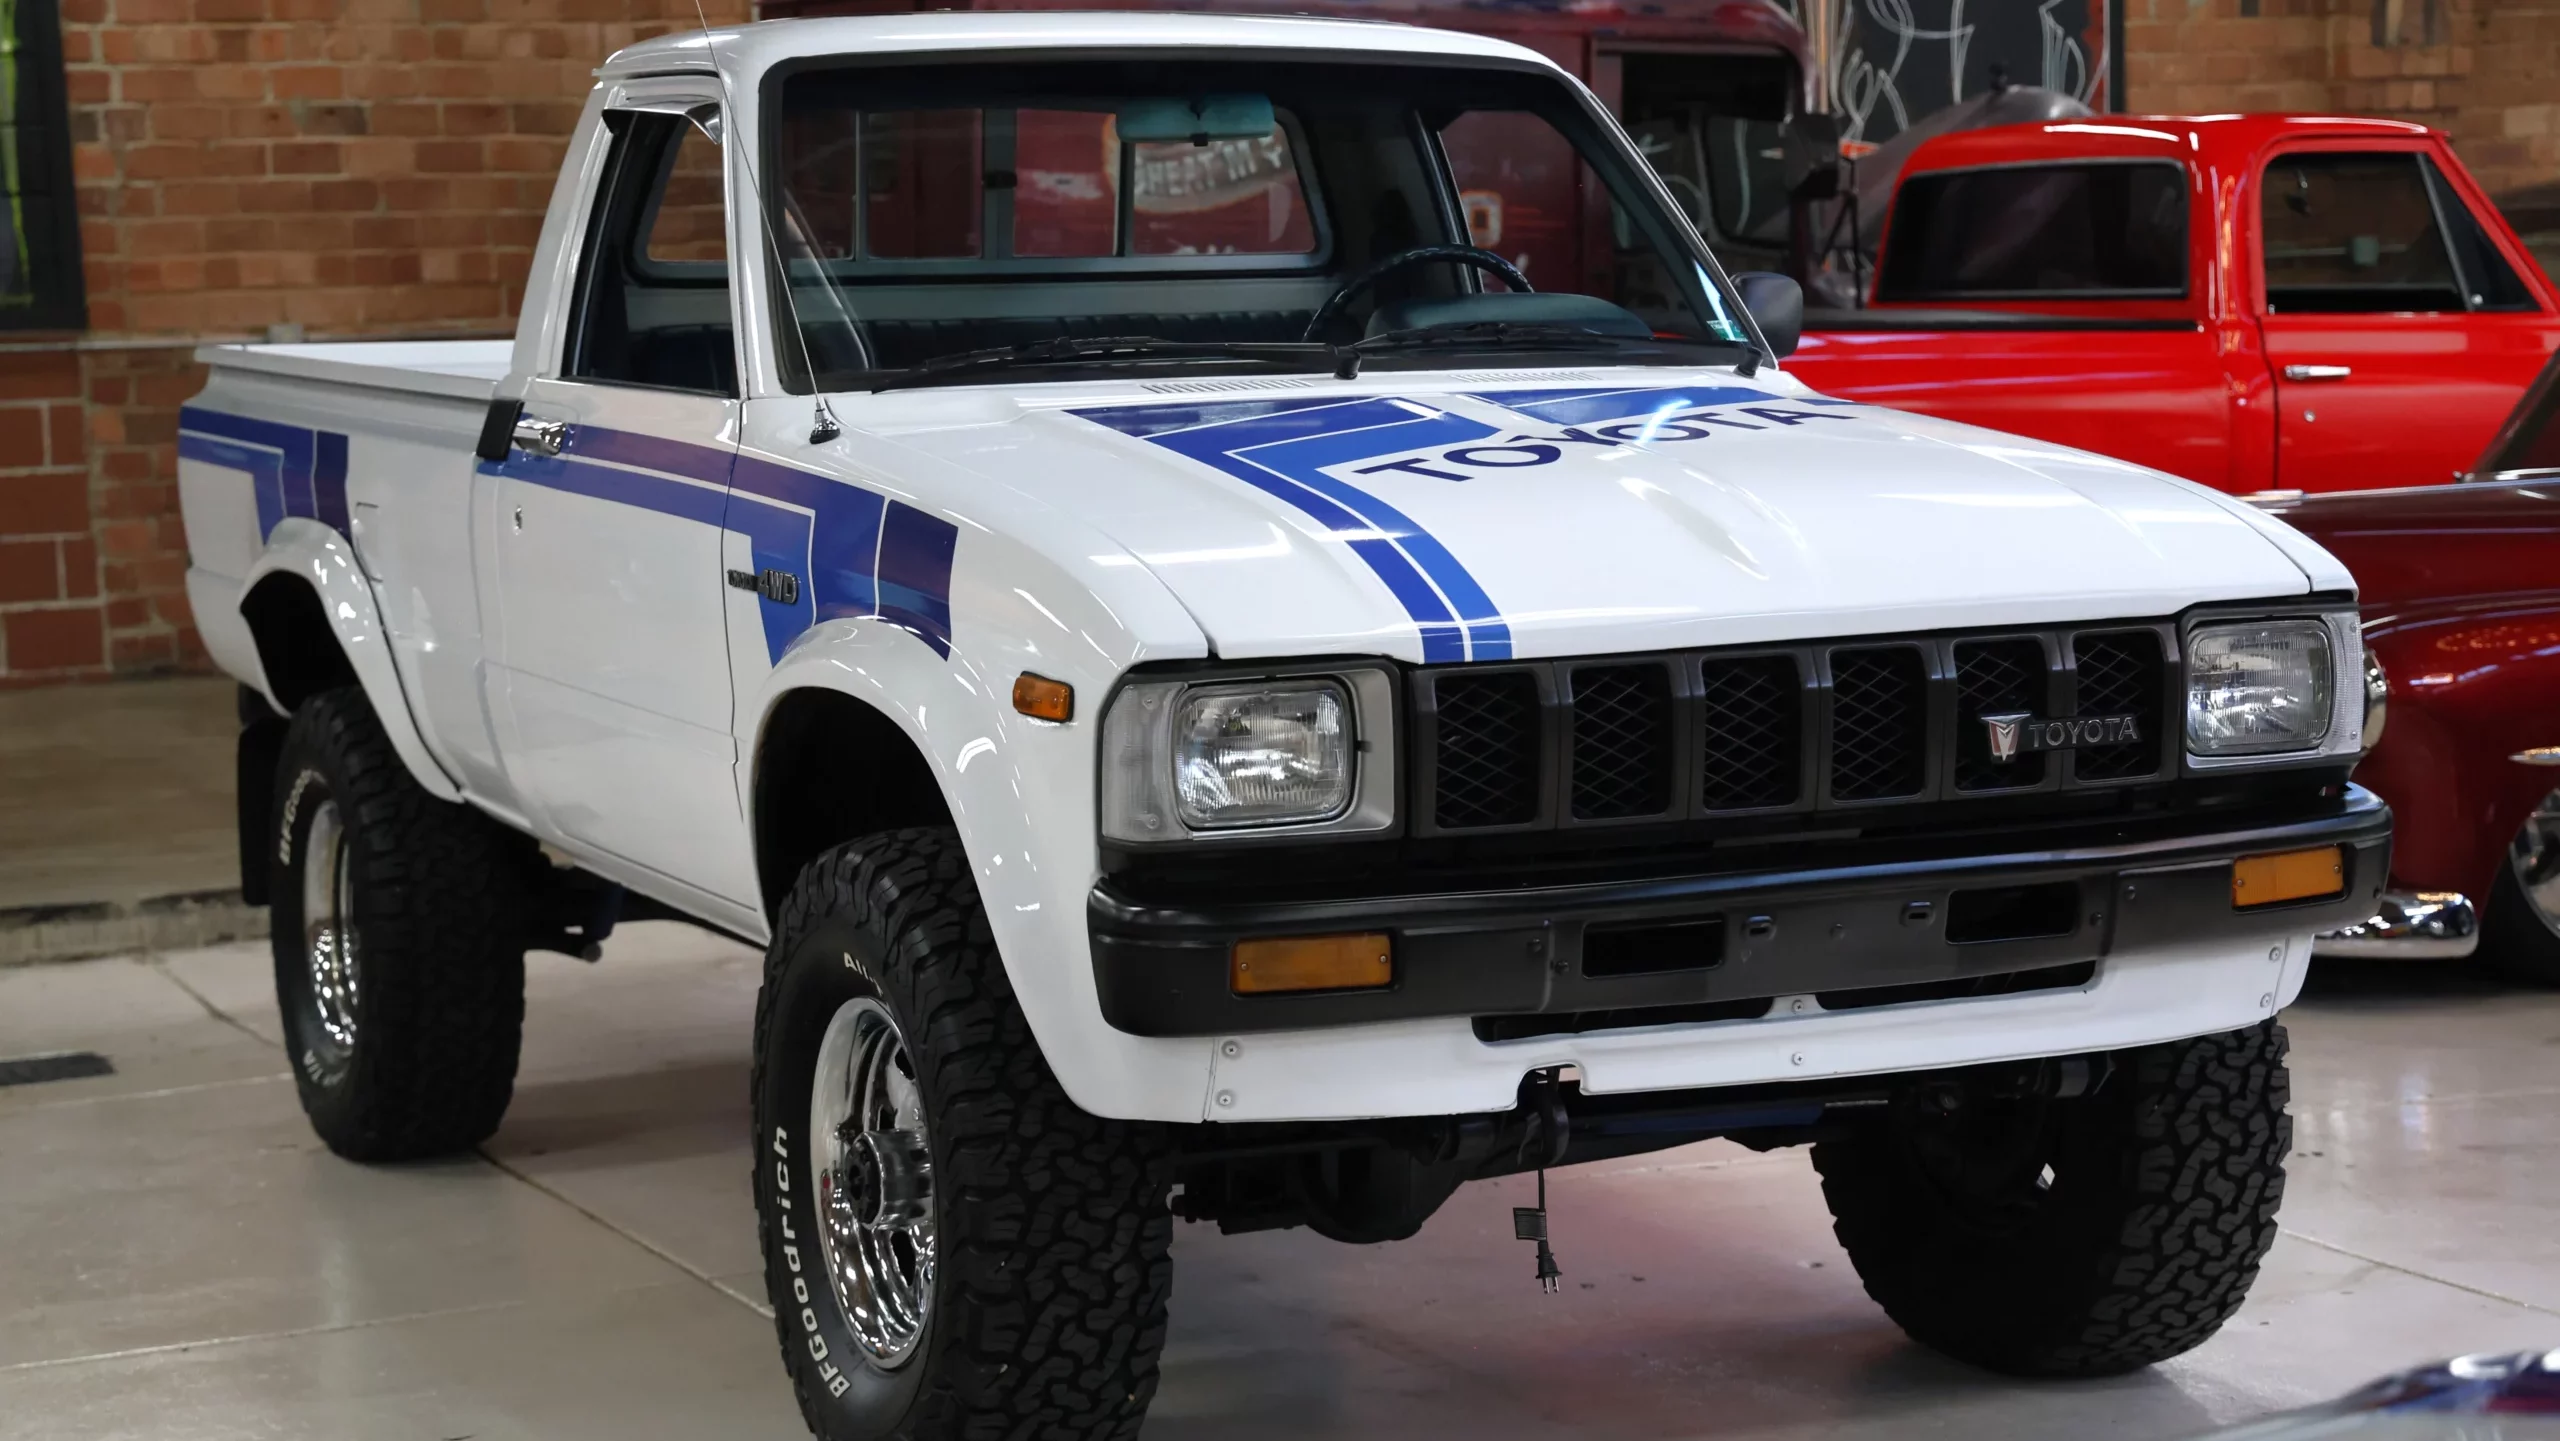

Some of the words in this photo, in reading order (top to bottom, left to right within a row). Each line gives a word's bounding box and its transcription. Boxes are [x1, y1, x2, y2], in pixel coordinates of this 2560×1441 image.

[1354, 407, 1857, 482] TOYOTA
[758, 569, 797, 604] 4WD
[2029, 716, 2138, 748] TOYOTA
[773, 1126, 851, 1399] BFGoodrich
